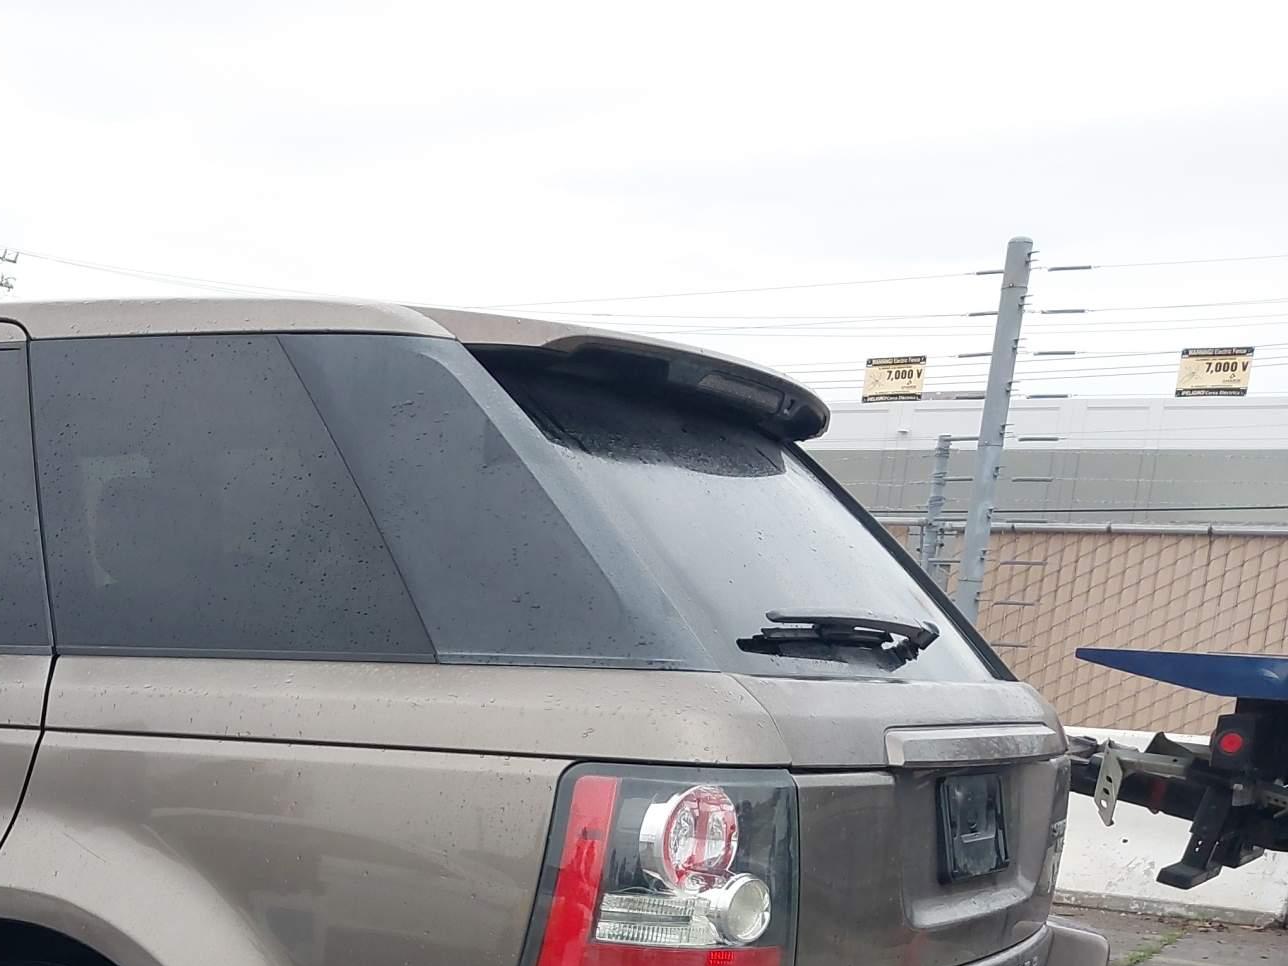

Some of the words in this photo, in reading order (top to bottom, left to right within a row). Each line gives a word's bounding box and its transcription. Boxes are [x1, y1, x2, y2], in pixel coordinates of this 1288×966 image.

[1205, 361, 1238, 374] 7,000
[1242, 361, 1249, 372] V
[887, 369, 914, 381] 7,000
[916, 368, 923, 379] V
